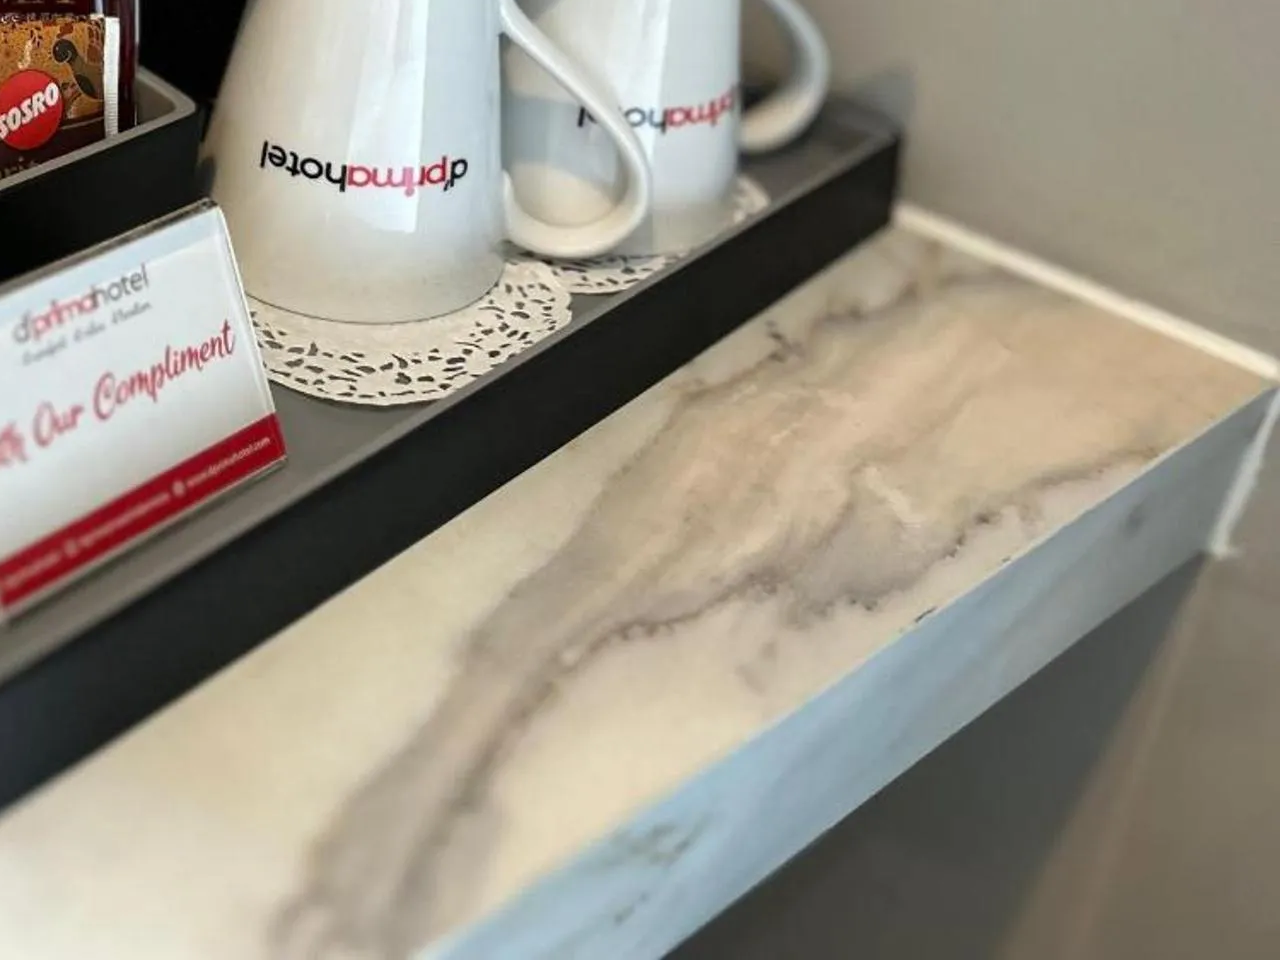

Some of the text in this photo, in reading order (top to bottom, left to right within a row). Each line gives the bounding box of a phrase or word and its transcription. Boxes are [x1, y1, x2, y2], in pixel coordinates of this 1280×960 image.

[260, 140, 468, 197] d'primahotel
[33, 400, 86, 448] Our
[93, 319, 237, 420] Compliment
